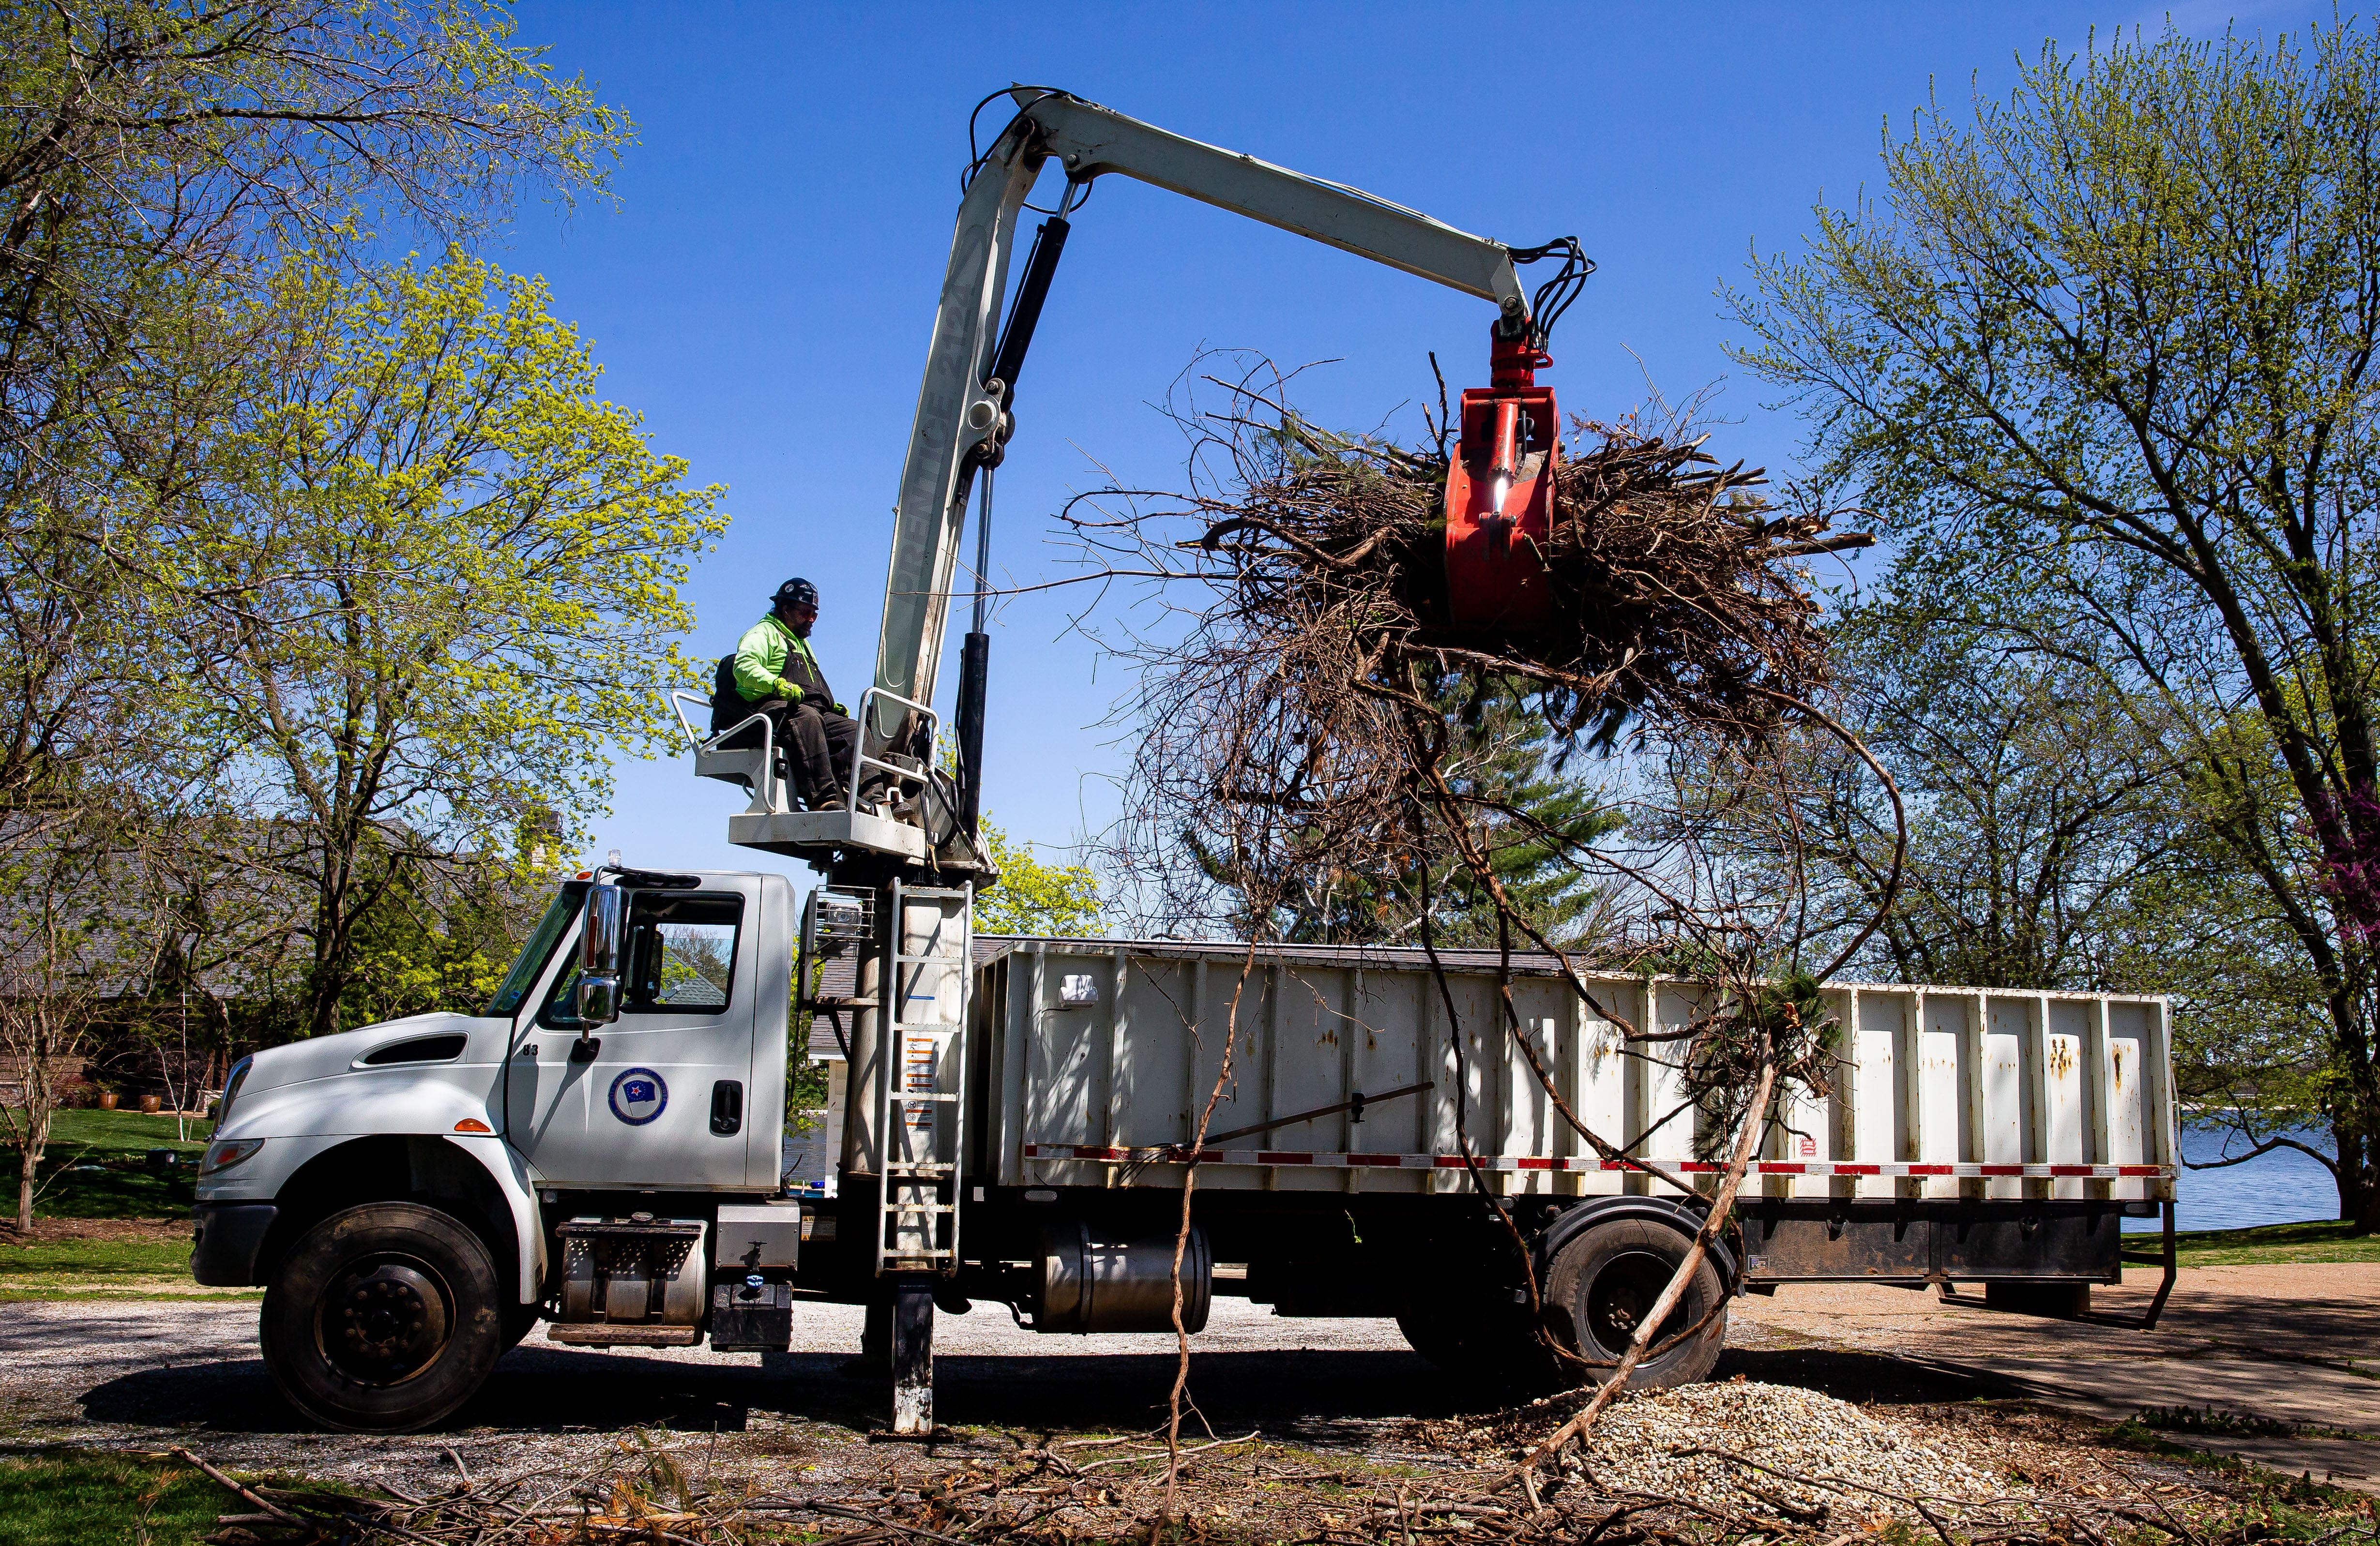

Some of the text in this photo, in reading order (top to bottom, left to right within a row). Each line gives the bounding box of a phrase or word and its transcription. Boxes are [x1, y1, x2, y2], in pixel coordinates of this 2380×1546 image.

[895, 282, 973, 604] PRENTICE 2124
[523, 1044, 538, 1056] 83
[614, 1069, 631, 1086] WATER
[659, 1080, 667, 1102] POWER
